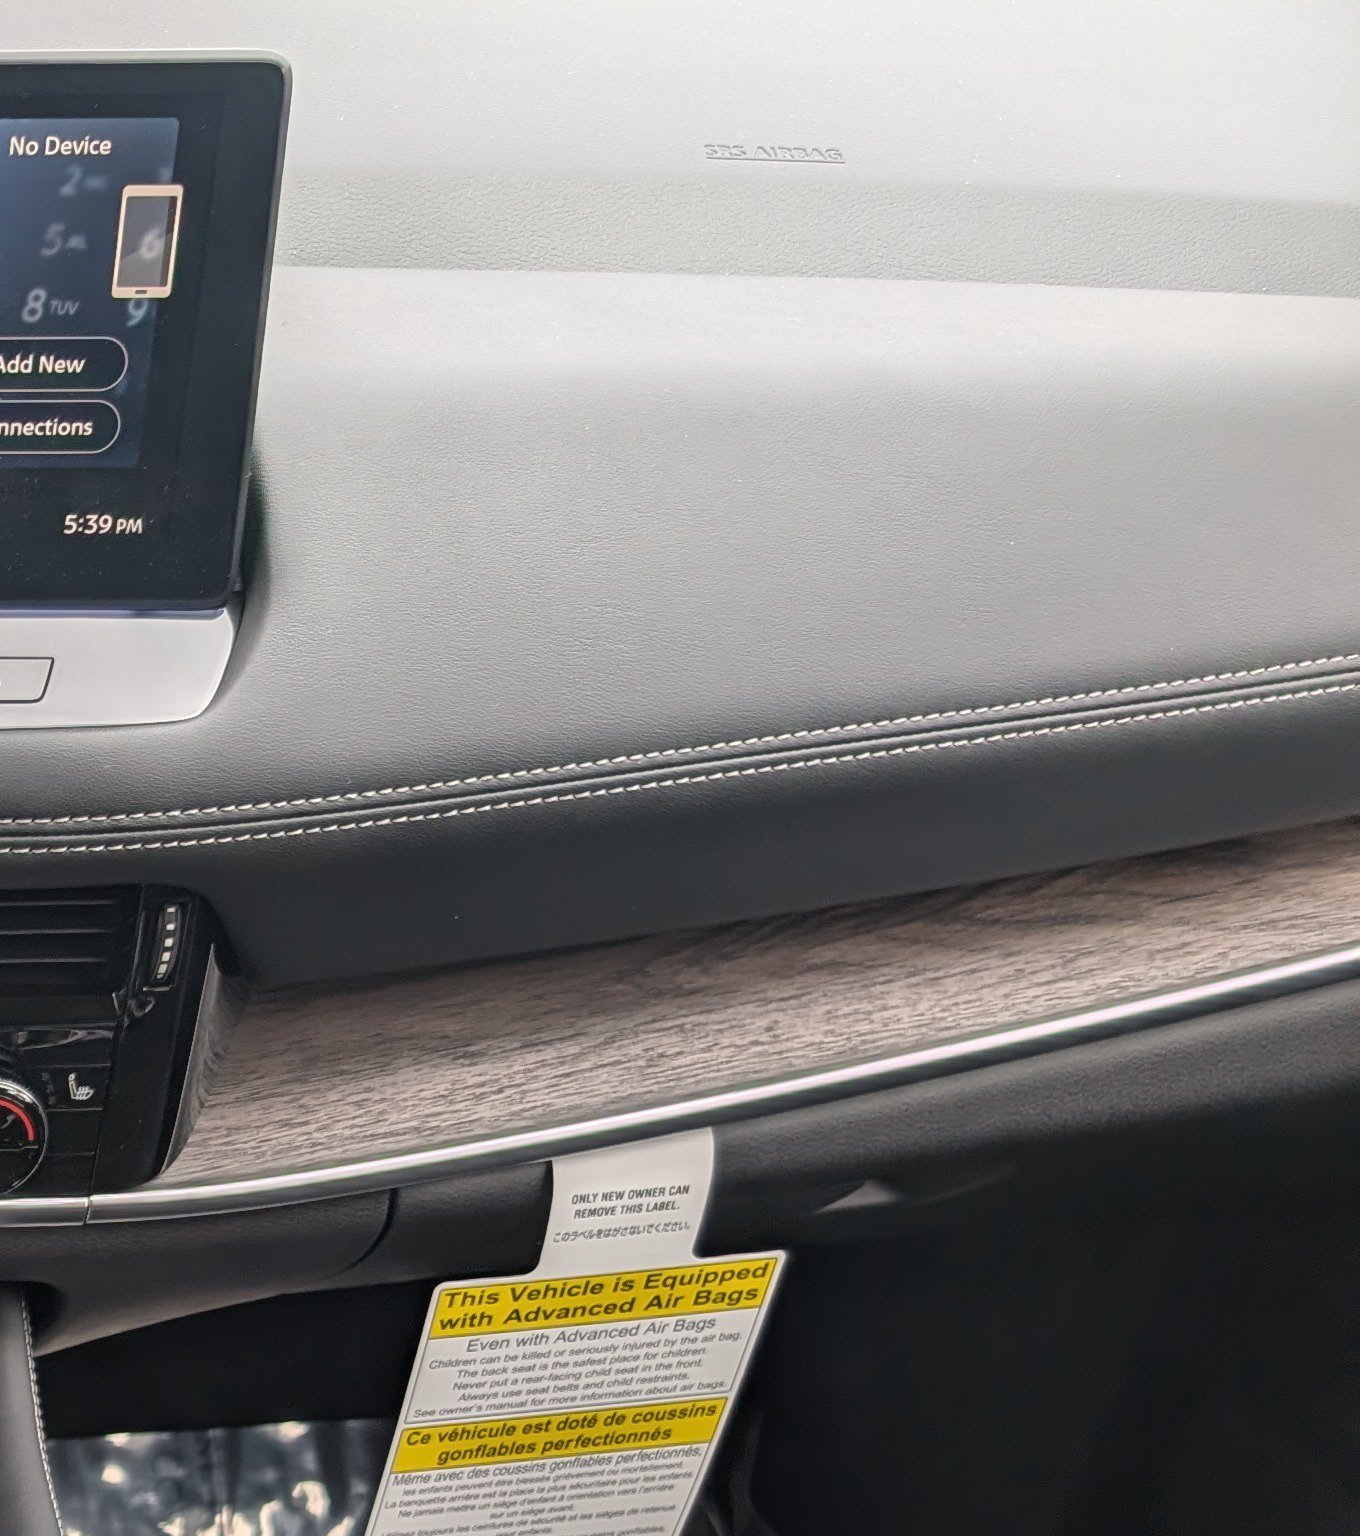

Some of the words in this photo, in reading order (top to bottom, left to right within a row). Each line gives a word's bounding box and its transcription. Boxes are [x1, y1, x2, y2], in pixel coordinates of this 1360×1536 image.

[9, 136, 39, 156] No
[44, 136, 113, 156] Device
[38, 354, 86, 375] New
[63, 514, 113, 537] 5:39
[115, 518, 144, 536] PM
[571, 1192, 598, 1205] ONLY
[601, 1190, 625, 1202] NEW
[628, 1187, 666, 1200] OWNER
[668, 1184, 691, 1196] CAN
[573, 1205, 617, 1219] REMOVE
[620, 1202, 644, 1215] THIS
[645, 1200, 680, 1213] LABEL.
[444, 1288, 502, 1308] This
[506, 1278, 606, 1303] Vehicle
[611, 1274, 638, 1292] is
[641, 1262, 770, 1292] Equipped
[438, 1311, 495, 1330] with
[502, 1296, 637, 1324] Advanced
[643, 1292, 683, 1310] Air
[690, 1285, 761, 1310] Bags
[427, 1356, 477, 1370] Children
[478, 1355, 501, 1365] can
[503, 1352, 519, 1362] be
[520, 1349, 552, 1360] killed
[553, 1349, 566, 1357] or
[567, 1343, 615, 1358] seriously
[620, 1338, 661, 1352] injured
[661, 1337, 678, 1348] by
[678, 1335, 699, 1345] the
[700, 1333, 716, 1343] air
[716, 1330, 744, 1343] bag.
[465, 1336, 511, 1352] Even
[514, 1331, 550, 1347] with
[552, 1323, 640, 1344] Advanced
[643, 1320, 670, 1335] Air
[671, 1315, 718, 1334] Bags
[451, 1379, 487, 1391] Never
[488, 1377, 509, 1389] put
[584, 1367, 612, 1378] child
[653, 1361, 674, 1371] the
[455, 1368, 479, 1379] The
[480, 1365, 509, 1376] back
[510, 1363, 537, 1373] seat
[550, 1359, 570, 1369] the
[572, 1355, 608, 1367] safest
[607, 1352, 641, 1365] place
[642, 1350, 659, 1360] for
[660, 1345, 709, 1359] children.
[404, 1429, 433, 1446] Ce
[436, 1421, 518, 1443] véhicule
[520, 1418, 552, 1434] est
[554, 1413, 600, 1431] doté
[602, 1410, 628, 1426] de
[629, 1401, 719, 1423] coussins
[435, 1438, 539, 1465] gonflables
[539, 1424, 675, 1455] perfectionnés
